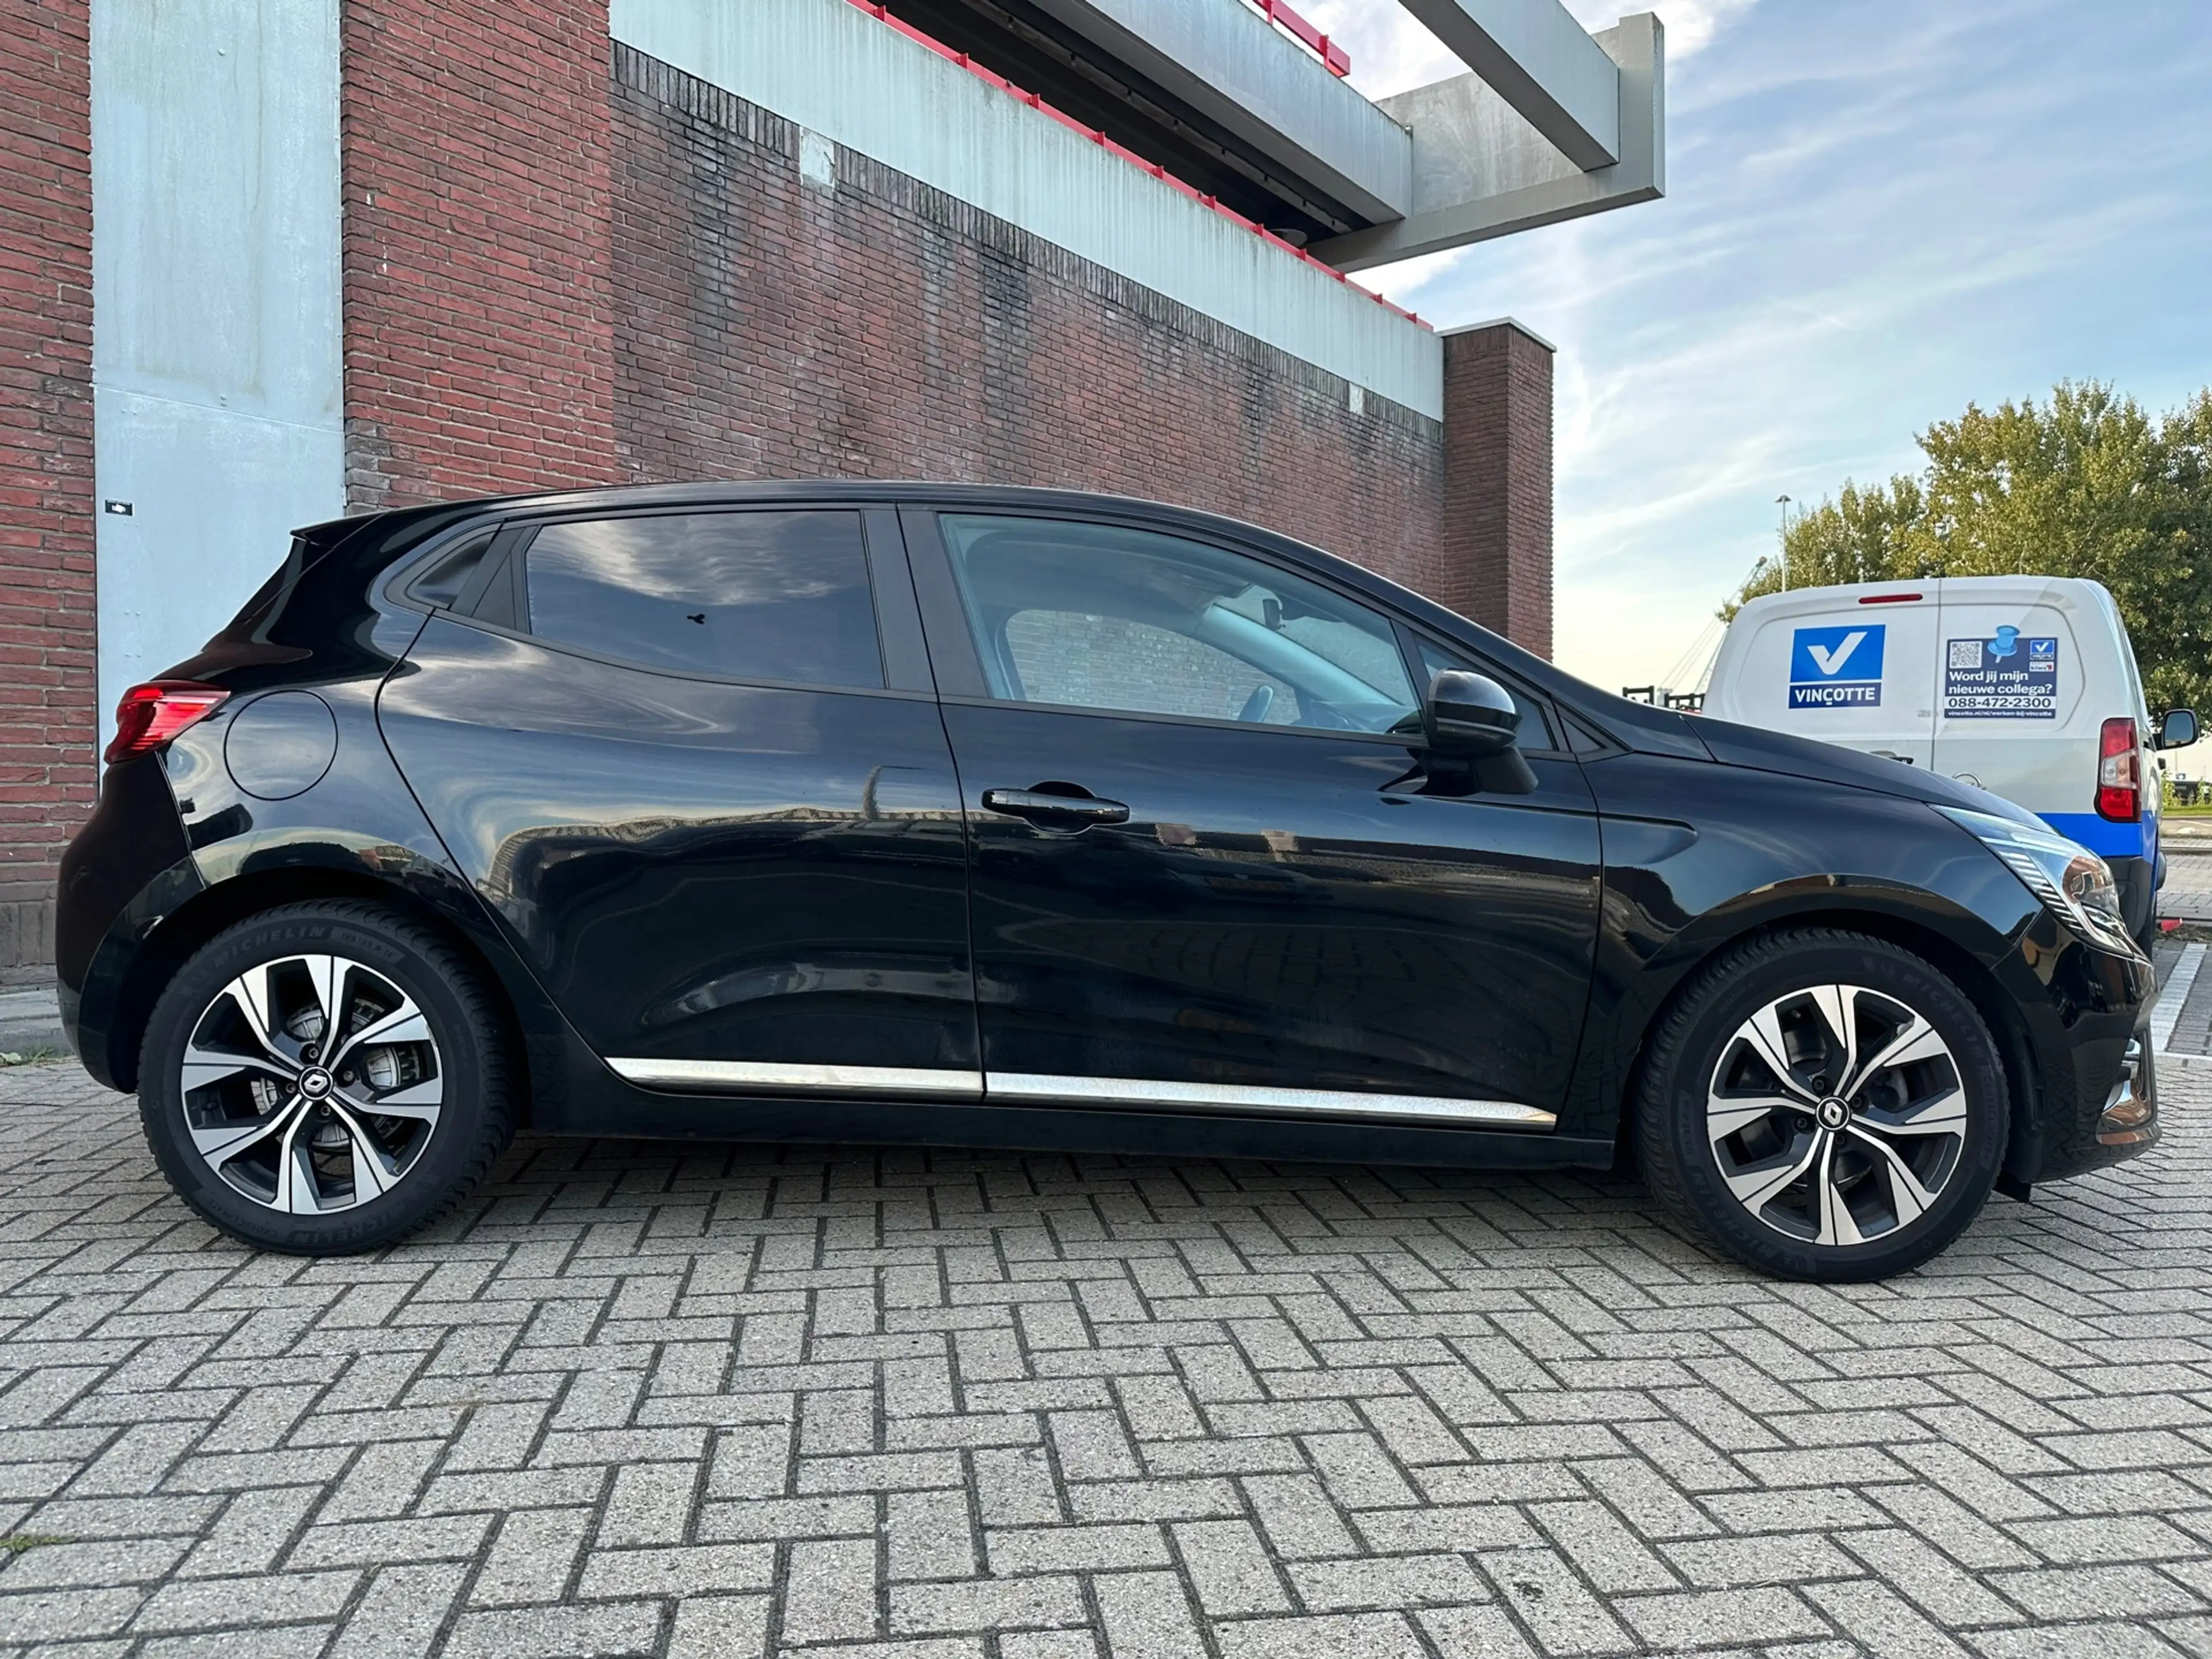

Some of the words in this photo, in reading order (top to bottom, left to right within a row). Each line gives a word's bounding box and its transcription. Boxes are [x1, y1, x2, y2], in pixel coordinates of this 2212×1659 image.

[1949, 671, 1984, 681] Word
[1986, 670, 1998, 683] jij
[1999, 671, 2029, 683] mijn
[1948, 684, 1995, 695] nieuwe
[1997, 683, 2053, 696] collega?
[1794, 687, 1876, 706] VINÇOTTE
[1948, 697, 2052, 708] 088-472-2300
[213, 926, 328, 969] MICHELIN
